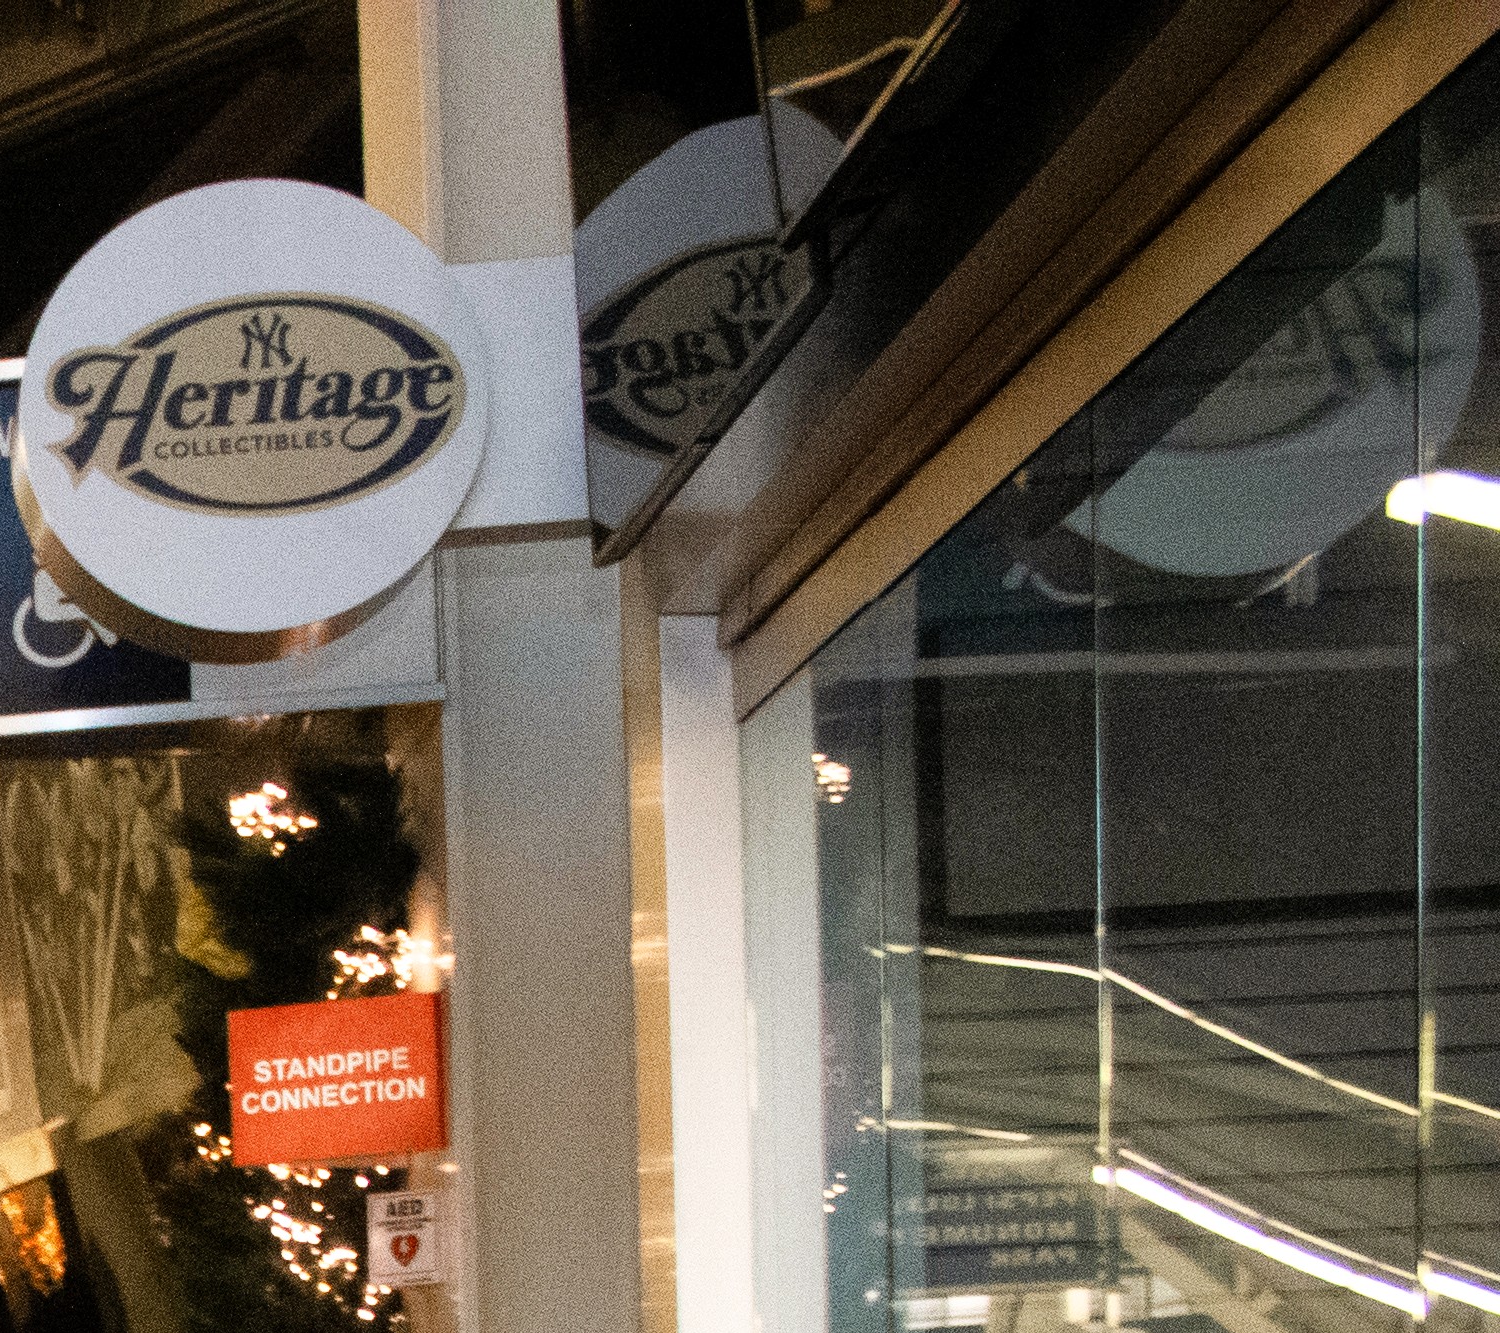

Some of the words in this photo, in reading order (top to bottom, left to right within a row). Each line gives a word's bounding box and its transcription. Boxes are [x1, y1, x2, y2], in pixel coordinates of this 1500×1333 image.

[52, 350, 455, 471] Heritage
[153, 428, 333, 460] COLLECTIBLES
[253, 1046, 410, 1084] STANDPIPE
[241, 1077, 426, 1115] CONNECTION
